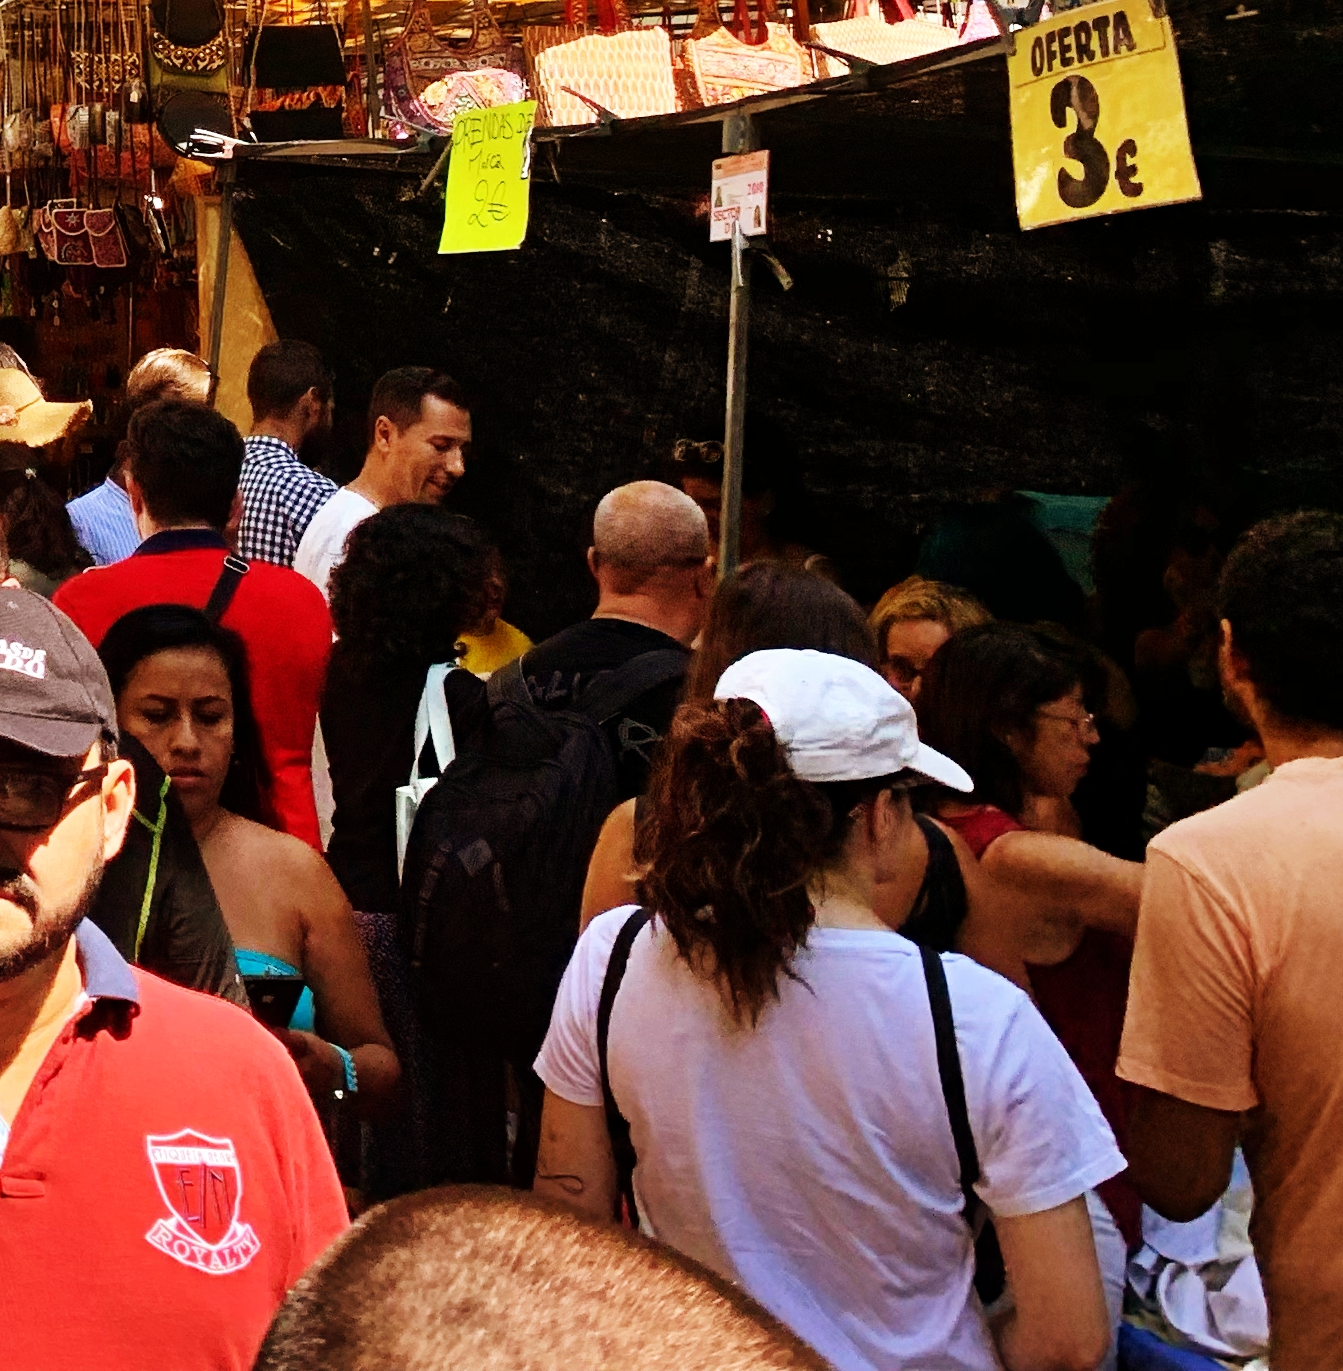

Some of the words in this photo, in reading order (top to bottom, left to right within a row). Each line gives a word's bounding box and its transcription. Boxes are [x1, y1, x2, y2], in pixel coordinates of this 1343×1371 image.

[1030, 10, 1137, 77] OFERTA
[454, 113, 513, 154] PRENDAS
[153, 1229, 257, 1271] ROYALTY
